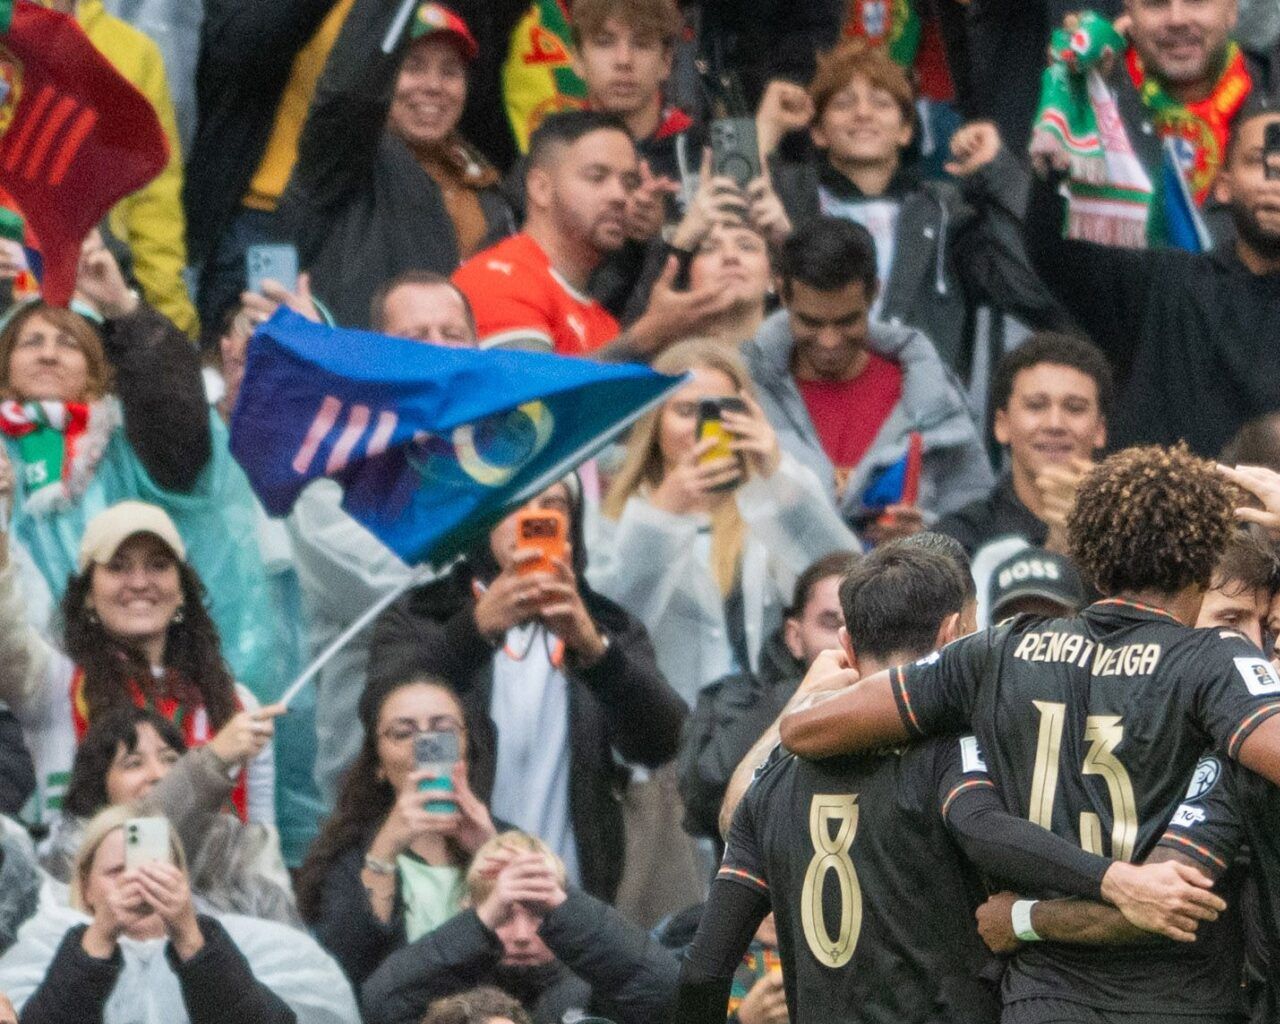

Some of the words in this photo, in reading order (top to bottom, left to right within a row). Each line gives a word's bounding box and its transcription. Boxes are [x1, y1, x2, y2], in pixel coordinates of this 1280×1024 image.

[999, 560, 1059, 587] BOSS
[1014, 631, 1094, 668] RENAT
[1091, 643, 1161, 677] VEIGA
[1029, 700, 1138, 863] 13
[801, 794, 863, 968] 8
